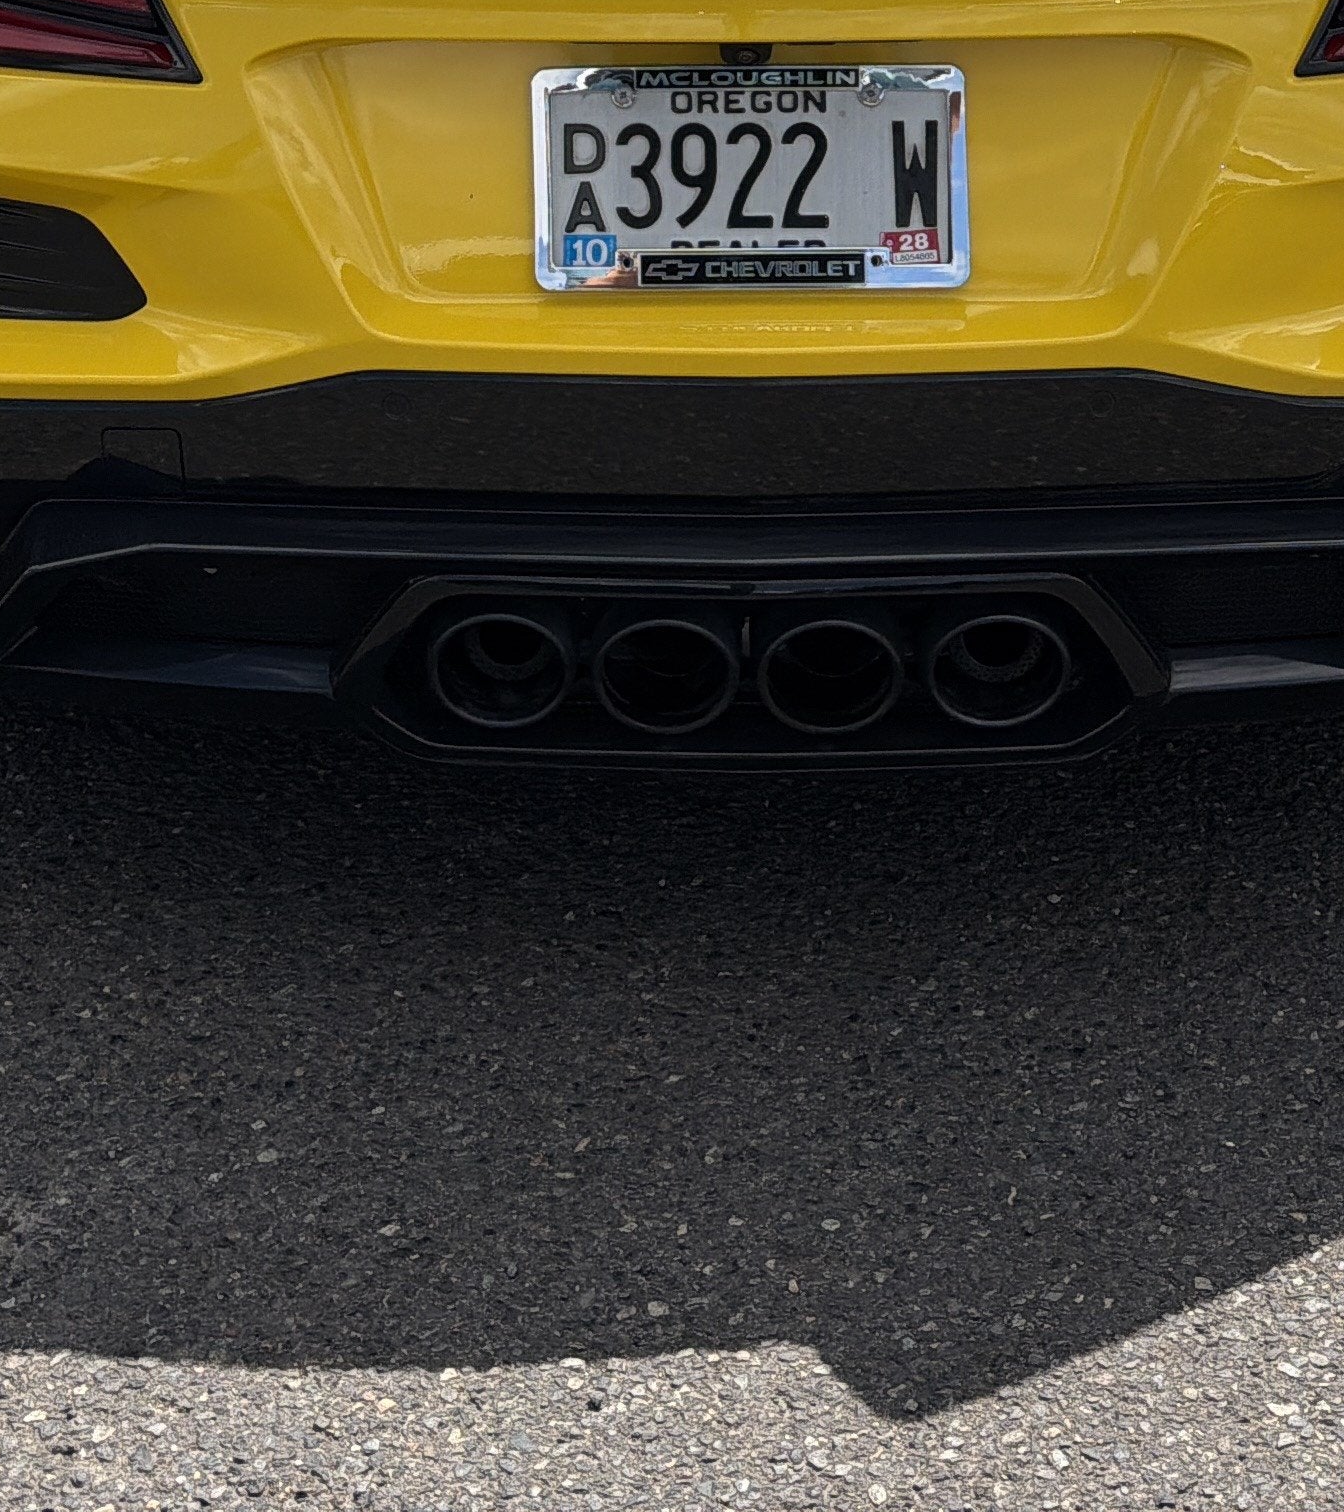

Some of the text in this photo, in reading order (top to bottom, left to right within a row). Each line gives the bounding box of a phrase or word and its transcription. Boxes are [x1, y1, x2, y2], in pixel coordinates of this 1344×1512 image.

[640, 70, 856, 88] MCLOUGHLIN
[670, 91, 827, 114] OREGON
[615, 121, 830, 229] 3922
[891, 120, 938, 228] W
[898, 232, 929, 251] 28
[572, 239, 607, 267] 10
[705, 260, 860, 278] CHEVROLET
